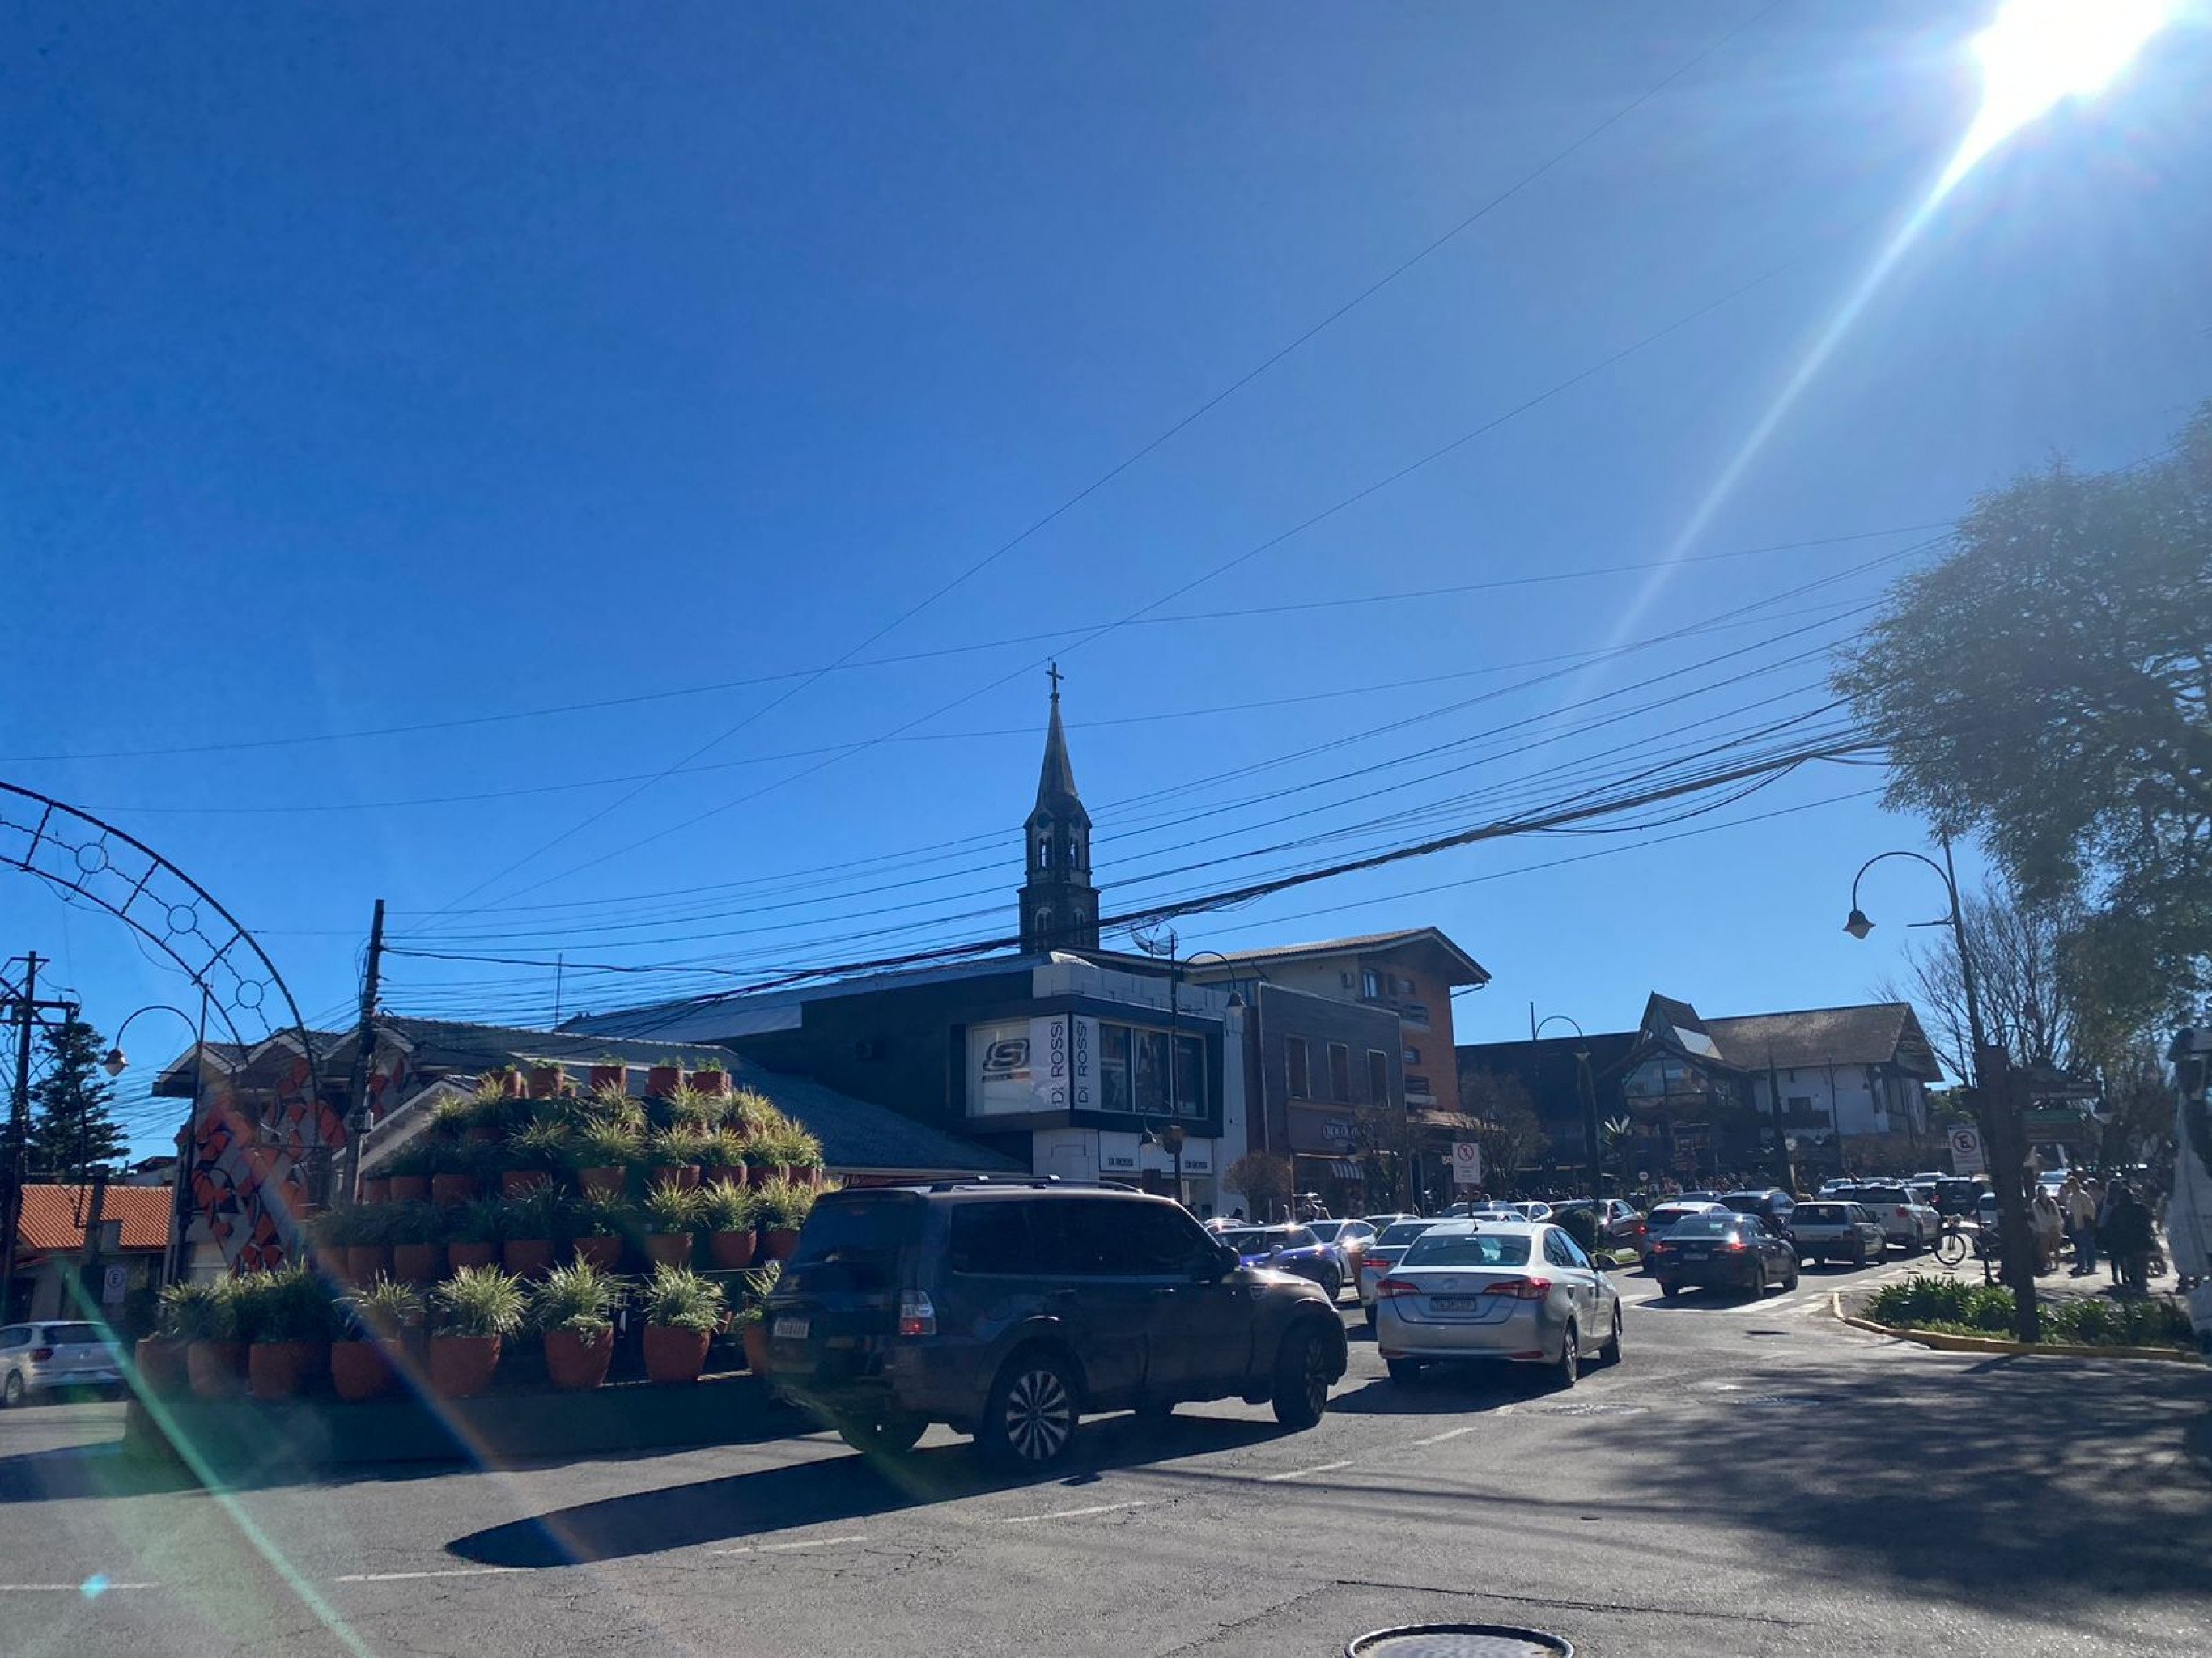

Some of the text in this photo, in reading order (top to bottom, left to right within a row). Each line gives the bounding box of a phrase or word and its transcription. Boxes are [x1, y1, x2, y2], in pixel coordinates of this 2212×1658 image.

[1051, 1021, 1064, 1104] DI ROSSI
[1077, 1021, 1088, 1103] DI ROSSI
